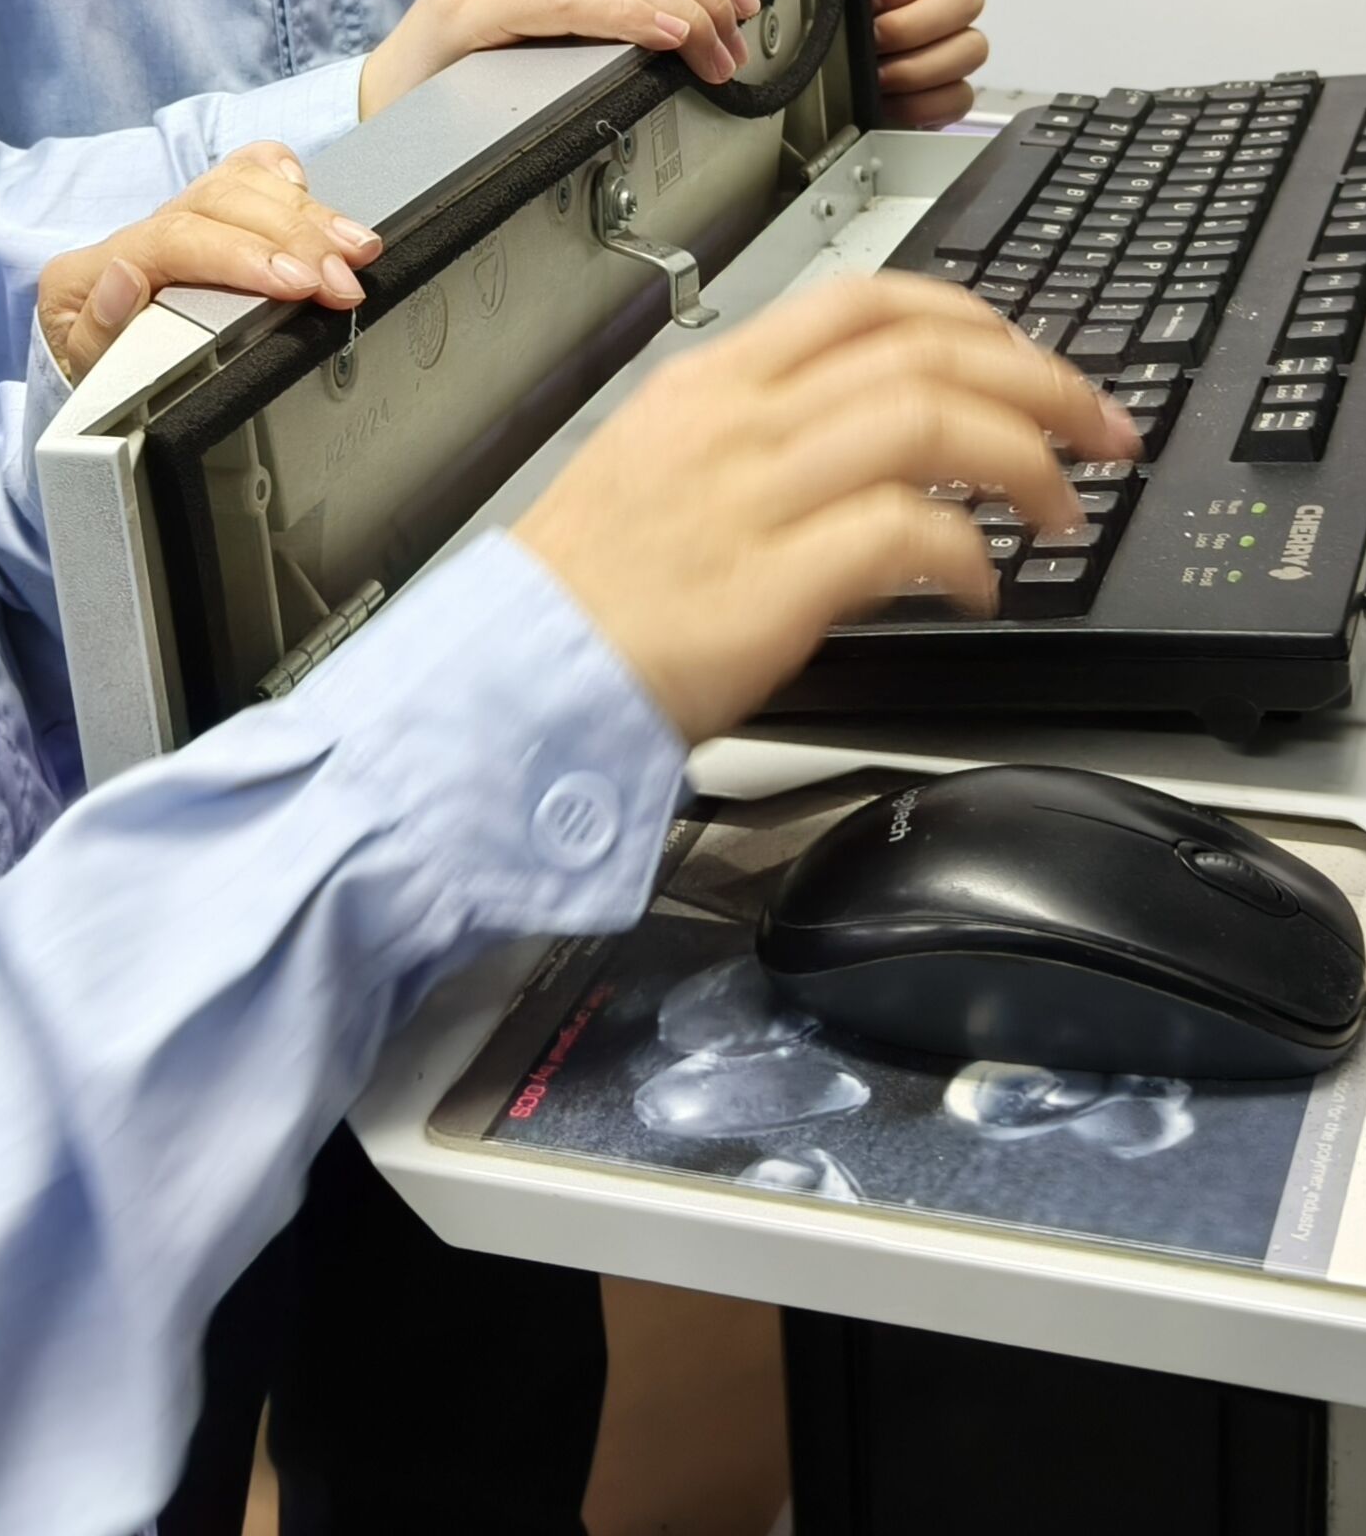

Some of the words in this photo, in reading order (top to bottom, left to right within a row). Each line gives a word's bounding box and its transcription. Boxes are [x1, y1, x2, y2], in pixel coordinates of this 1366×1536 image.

[1109, 123, 1128, 133] Z
[1160, 128, 1180, 137] S
[1211, 133, 1230, 142] E
[1098, 138, 1119, 149] X
[1150, 144, 1170, 153] D
[1202, 149, 1221, 158] R
[1088, 154, 1108, 165] C
[1142, 160, 1161, 169] F
[1193, 166, 1213, 175] T
[1077, 172, 1097, 181] V
[1130, 178, 1150, 188] G
[1065, 188, 1085, 198] B
[1183, 184, 1203, 194] Y
[1119, 195, 1140, 205] H
[1053, 206, 1074, 216] N
[1173, 201, 1195, 212] U
[1109, 214, 1128, 222] J
[1040, 223, 1061, 235] M
[1096, 231, 1119, 242] K
[1152, 241, 1173, 251] O
[1086, 252, 1106, 261] L
[1142, 261, 1162, 270] P
[1319, 297, 1334, 309] F11
[1310, 320, 1326, 333] F12
[1208, 499, 1226, 515] Lock
[1194, 532, 1213, 549] Lock
[1211, 532, 1232, 550] Caps
[1280, 504, 1325, 567] CHERRY
[990, 536, 1014, 549] 9
[1181, 567, 1200, 584] Lock
[1198, 567, 1219, 587] Scroll
[508, 1084, 546, 1119] OCS
[1326, 1103, 1347, 1120] for
[1320, 1122, 1341, 1142] the
[1308, 1141, 1332, 1190] polymer
[1290, 1191, 1321, 1242] industry
